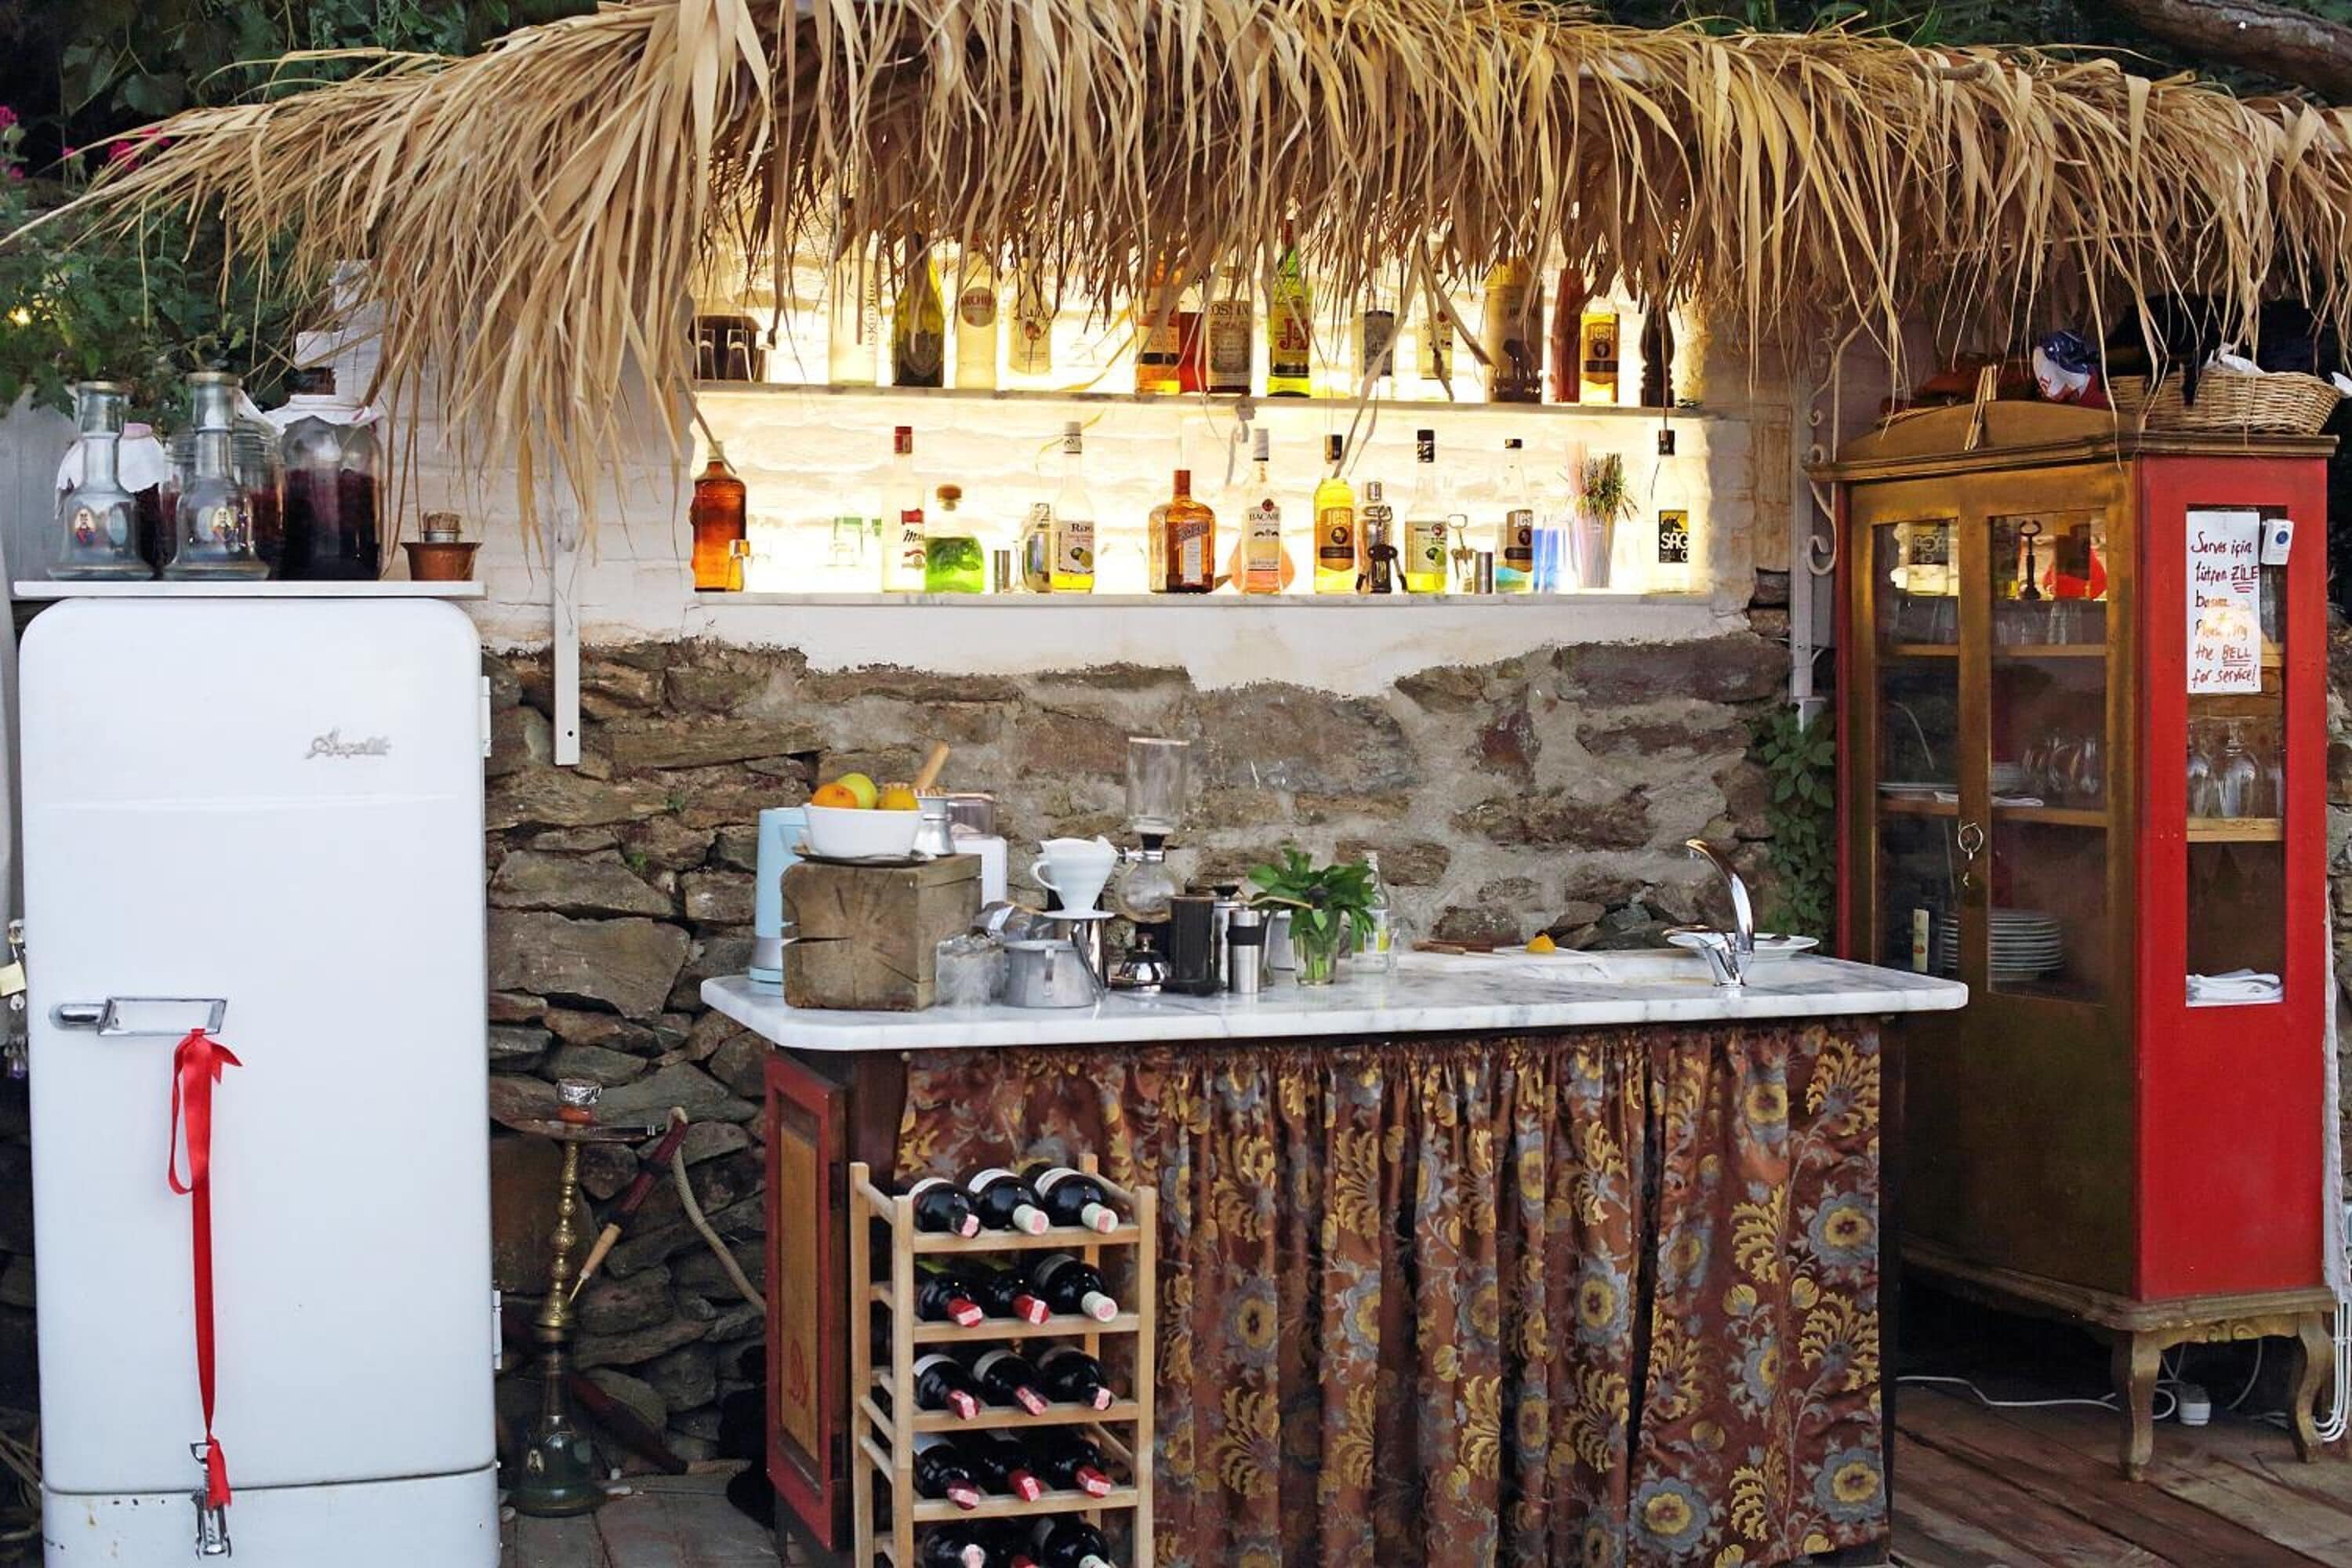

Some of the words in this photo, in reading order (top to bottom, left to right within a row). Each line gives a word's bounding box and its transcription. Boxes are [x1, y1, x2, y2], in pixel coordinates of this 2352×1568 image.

[2194, 643, 2214, 661] the
[2221, 644, 2252, 660] BELL
[2191, 669, 2212, 689] for
